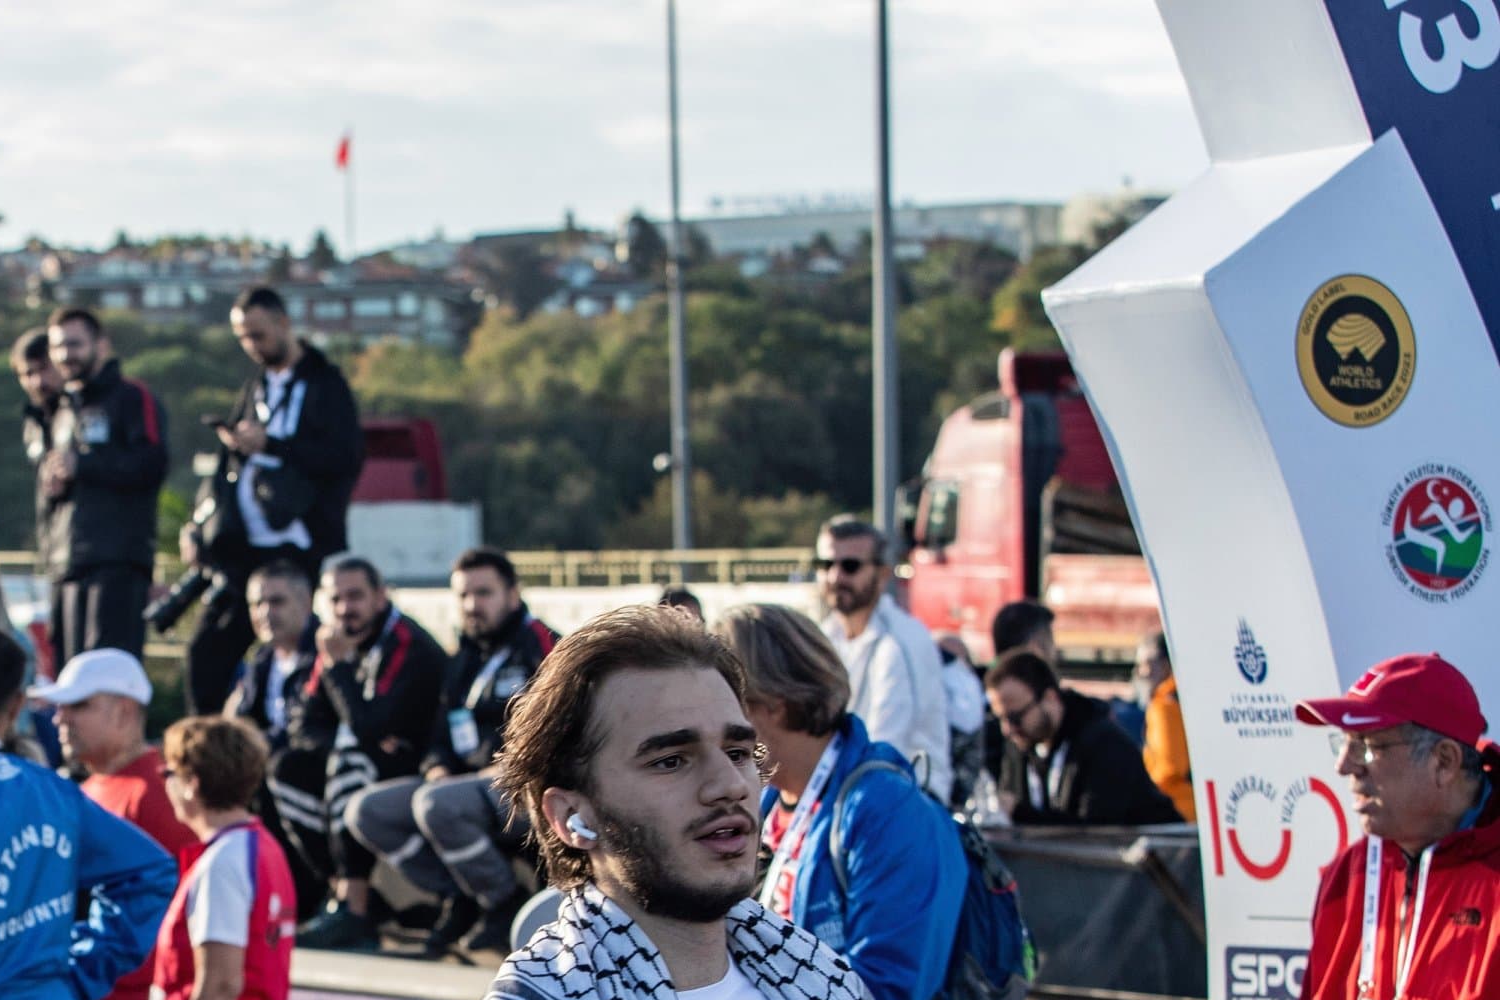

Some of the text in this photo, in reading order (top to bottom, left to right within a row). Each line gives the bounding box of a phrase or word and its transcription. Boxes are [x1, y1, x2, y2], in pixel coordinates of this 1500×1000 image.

[1385, 0, 1500, 93] 3
[1302, 283, 1346, 335] GOLD LABEL
[1329, 376, 1383, 390] ATHLETICS
[1338, 365, 1375, 378] WORLD
[1353, 407, 1381, 421] ROAD
[1381, 385, 1404, 410] RACE
[1223, 706, 1293, 724] BÜYÜKŞEHİ
[1231, 953, 1309, 998] SPO
